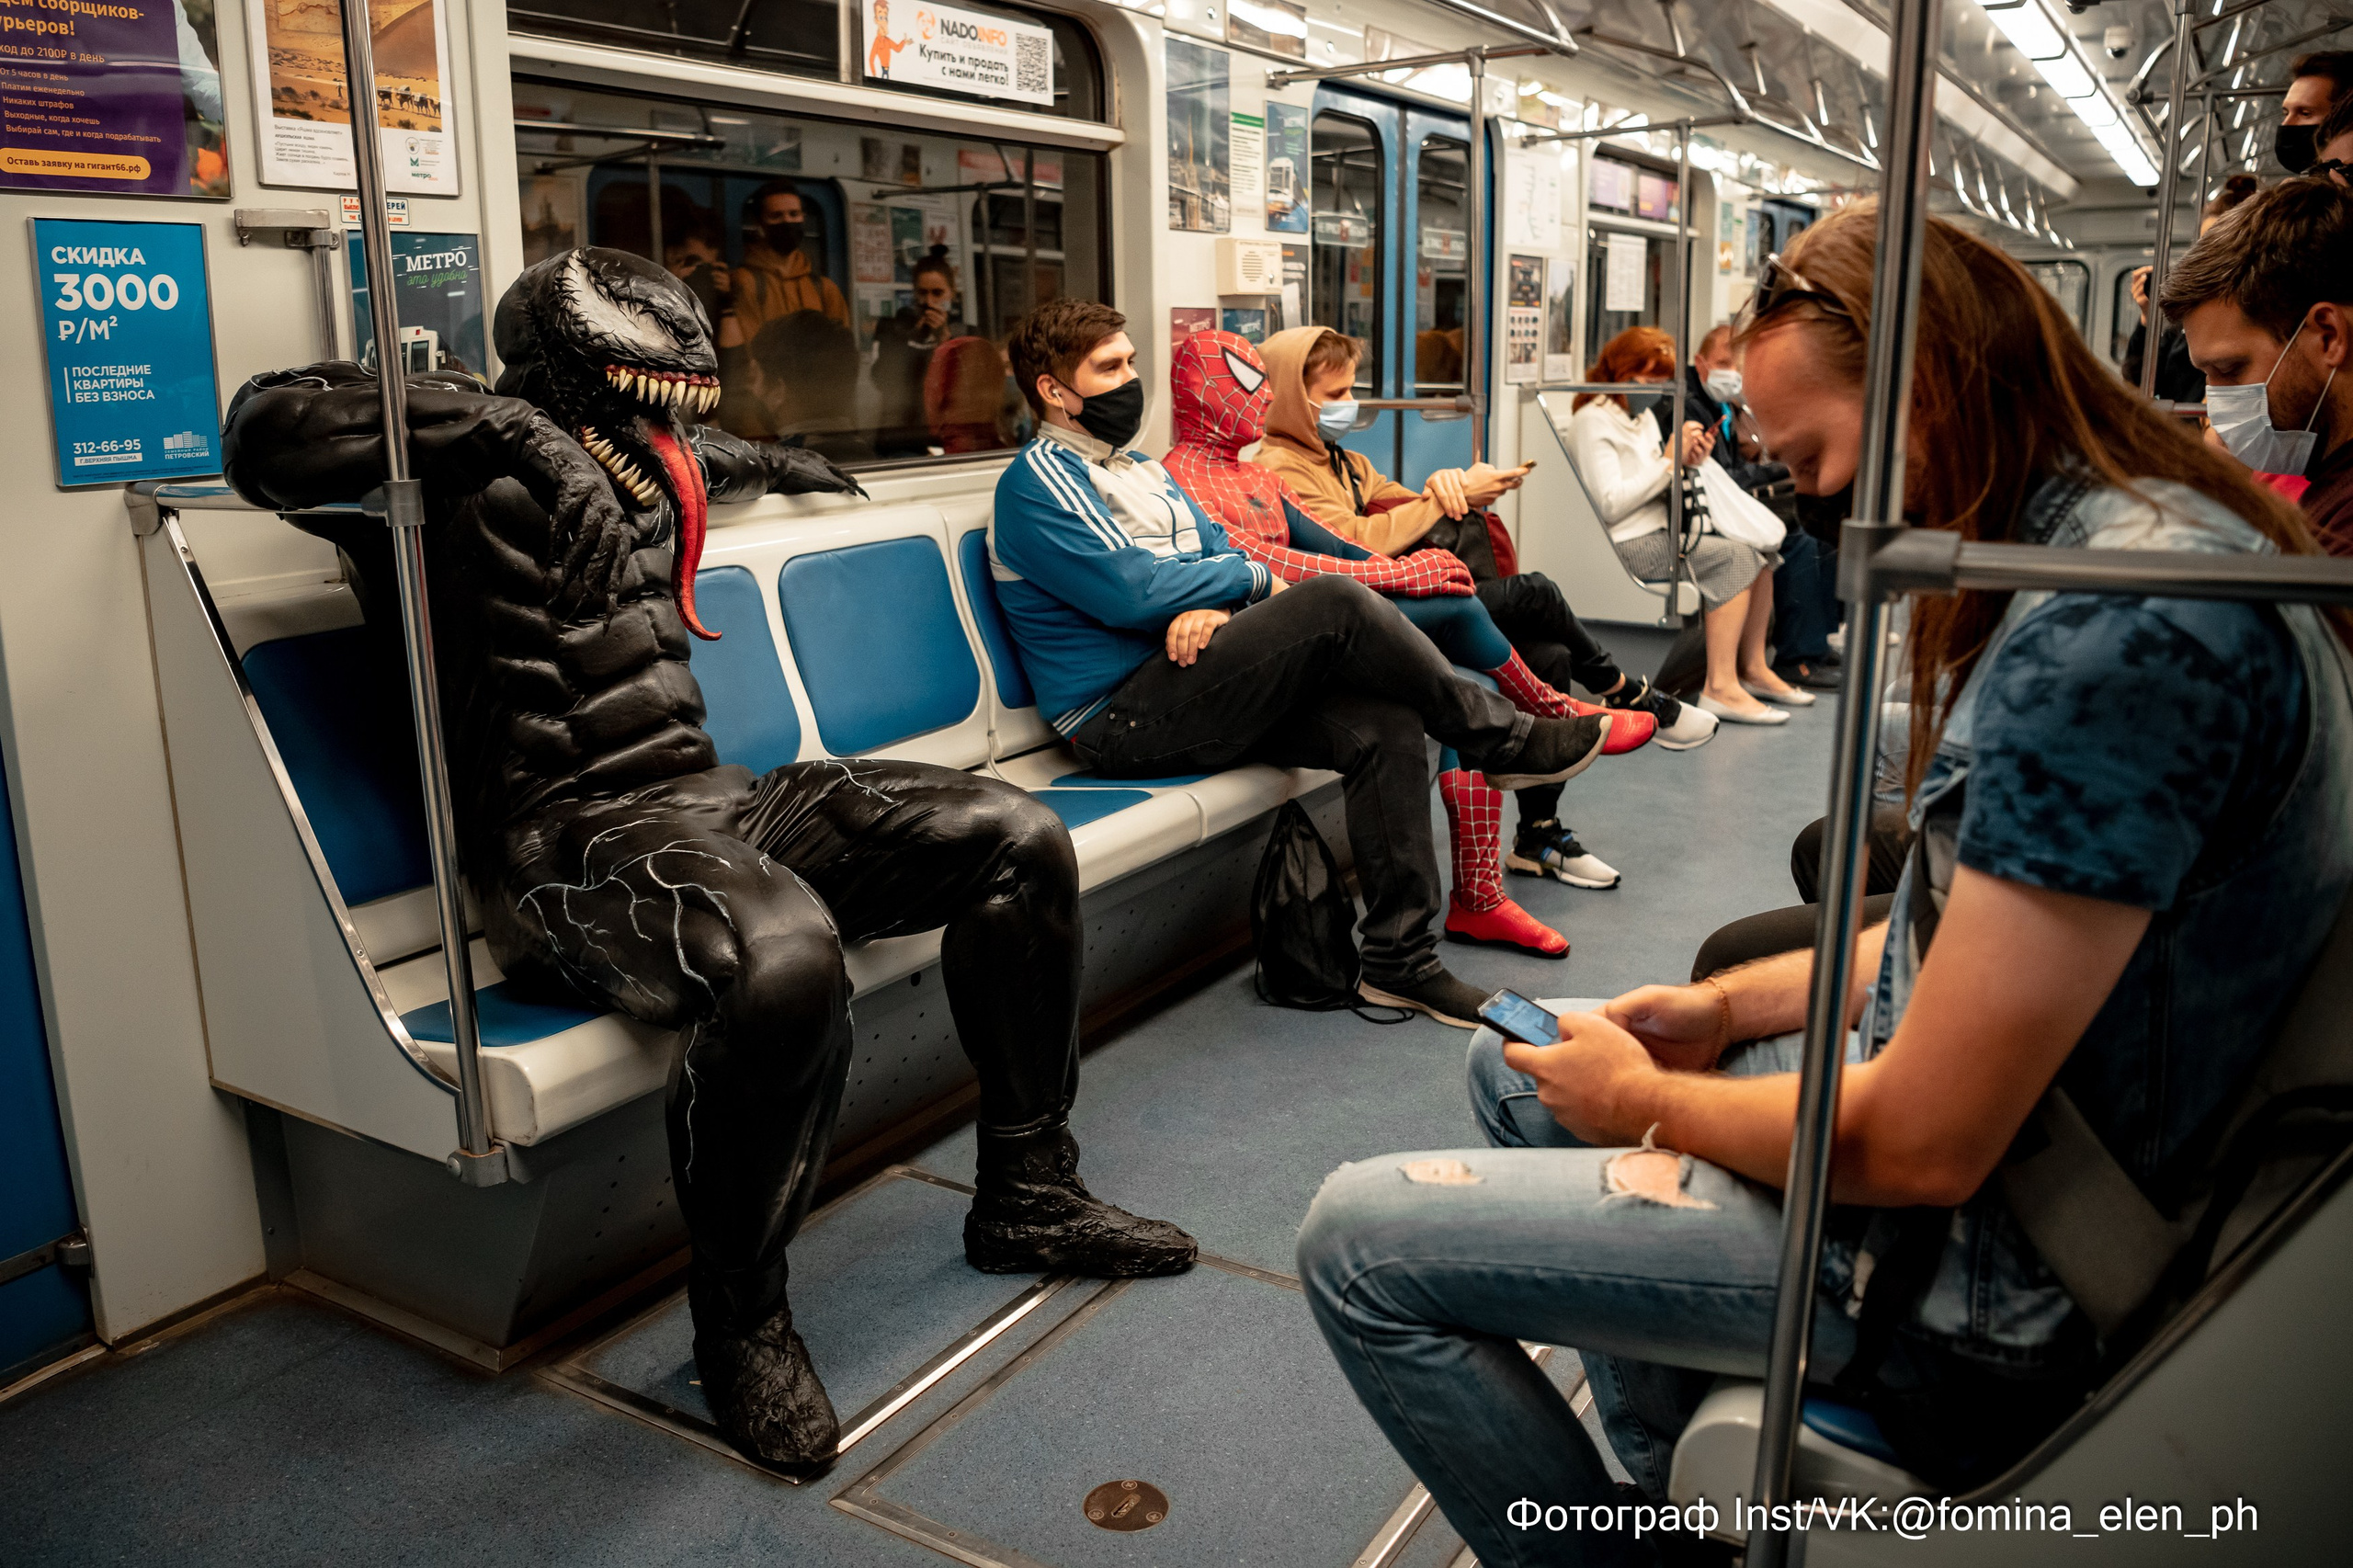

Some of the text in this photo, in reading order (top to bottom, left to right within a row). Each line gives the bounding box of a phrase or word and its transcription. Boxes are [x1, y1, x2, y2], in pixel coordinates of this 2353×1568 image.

[0, 15, 75, 36] рьеров!
[940, 18, 1007, 47] NADO.INFO
[20, 47, 34, 56] до
[79, 53, 105, 63] день
[919, 44, 1009, 73] Купить и продать
[0, 67, 9, 75] От
[11, 68, 17, 76] 5
[18, 70, 41, 79] часов
[50, 73, 69, 81] день
[941, 65, 947, 76] с
[949, 67, 975, 80] нами
[978, 72, 1009, 85] легко!
[1, 82, 85, 97] Платим еженедельно
[3, 96, 74, 110] Никаких штрафов
[4, 110, 48, 121] Выходные,
[49, 115, 70, 123] когда
[6, 125, 42, 135] Выбирай
[43, 128, 61, 136] сам,
[83, 131, 103, 140] когда
[105, 132, 161, 143] подрабатывать
[6, 156, 40, 166] Оставь
[41, 160, 72, 170] заявку
[87, 163, 141, 174] гигант66.рф
[387, 201, 406, 210] ЕРЕЙ
[51, 246, 146, 267] СКИДКА
[405, 251, 467, 272] МЕТРО
[406, 269, 468, 288] это удобно
[53, 273, 179, 311] 3000
[72, 365, 152, 377] ПОСЛЕДНИЕ
[74, 378, 143, 390] КВАРТИРЫ
[75, 390, 155, 403] БЕЗ ВЗНОСА
[73, 438, 142, 454] 312-66-95
[165, 450, 210, 460] ПЕТРОВСКИЙ
